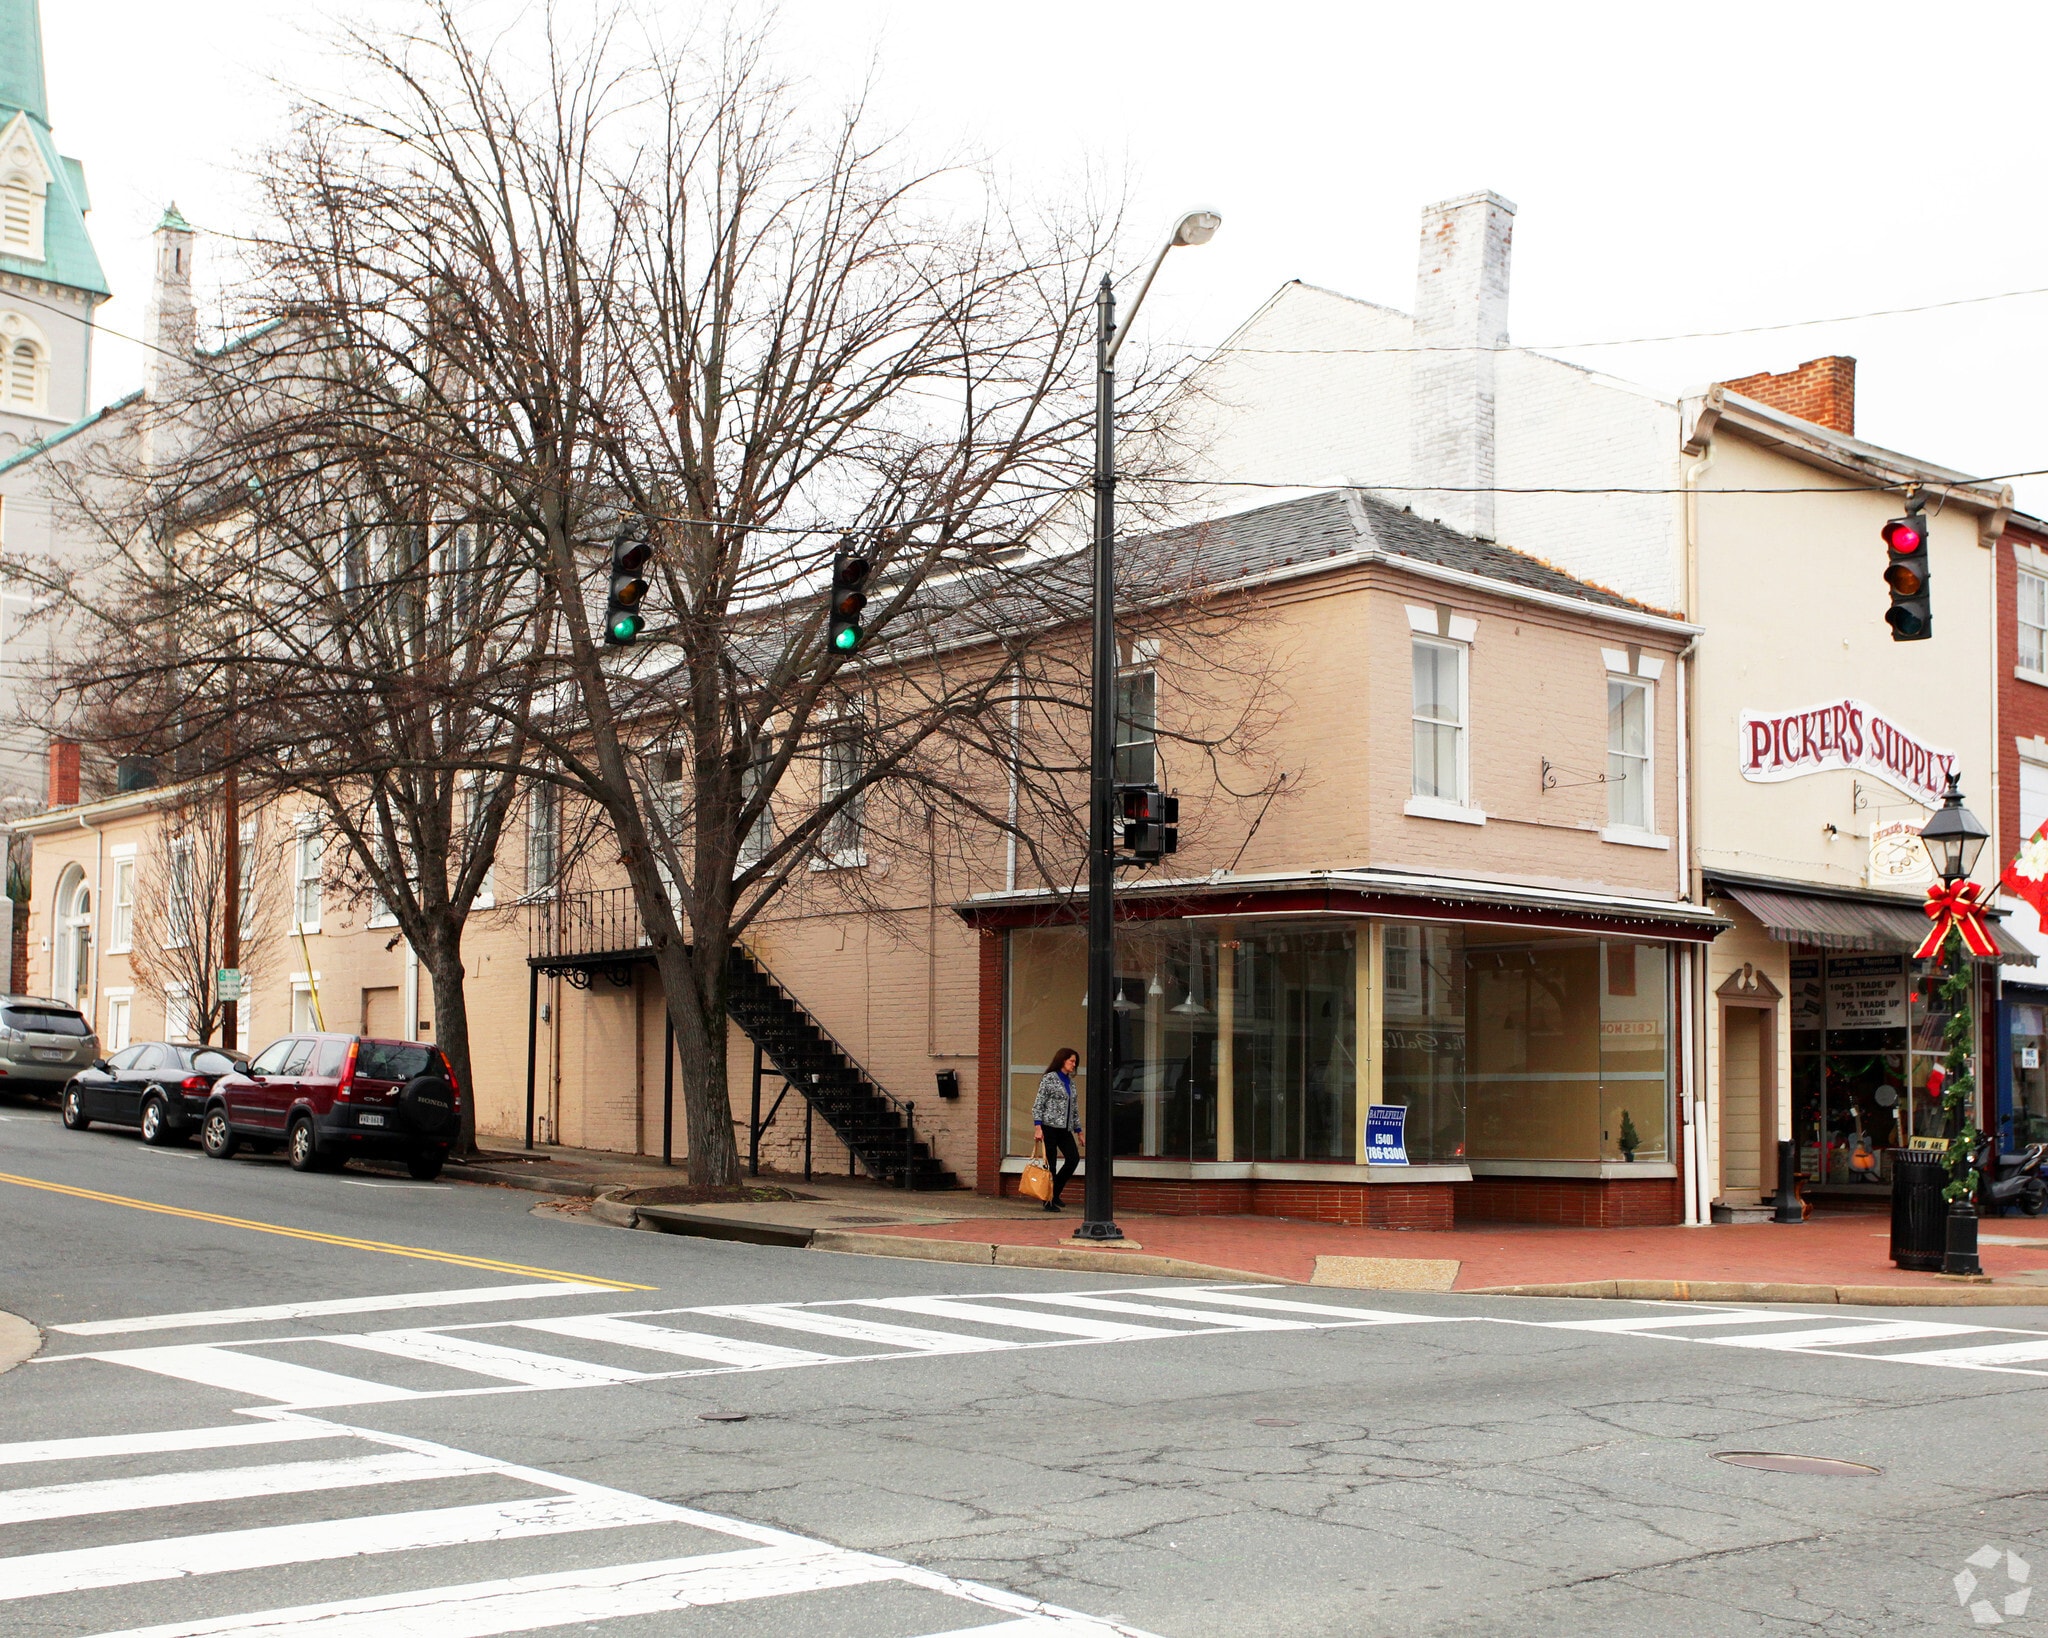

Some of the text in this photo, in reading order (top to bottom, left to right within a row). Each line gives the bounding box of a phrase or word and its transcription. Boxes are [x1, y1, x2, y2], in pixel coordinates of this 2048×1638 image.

[1748, 699, 1956, 794] PICKER'S SUPPLY
[1830, 980, 1896, 991] 100% TRADE UP
[1836, 999, 1900, 1010] 75% TRADE UP
[417, 1096, 449, 1109] HONDA
[1369, 1109, 1404, 1120] BATTLEFIELD
[1913, 1139, 1943, 1150] YOU ARE
[1366, 1146, 1405, 1160] 786-8300
